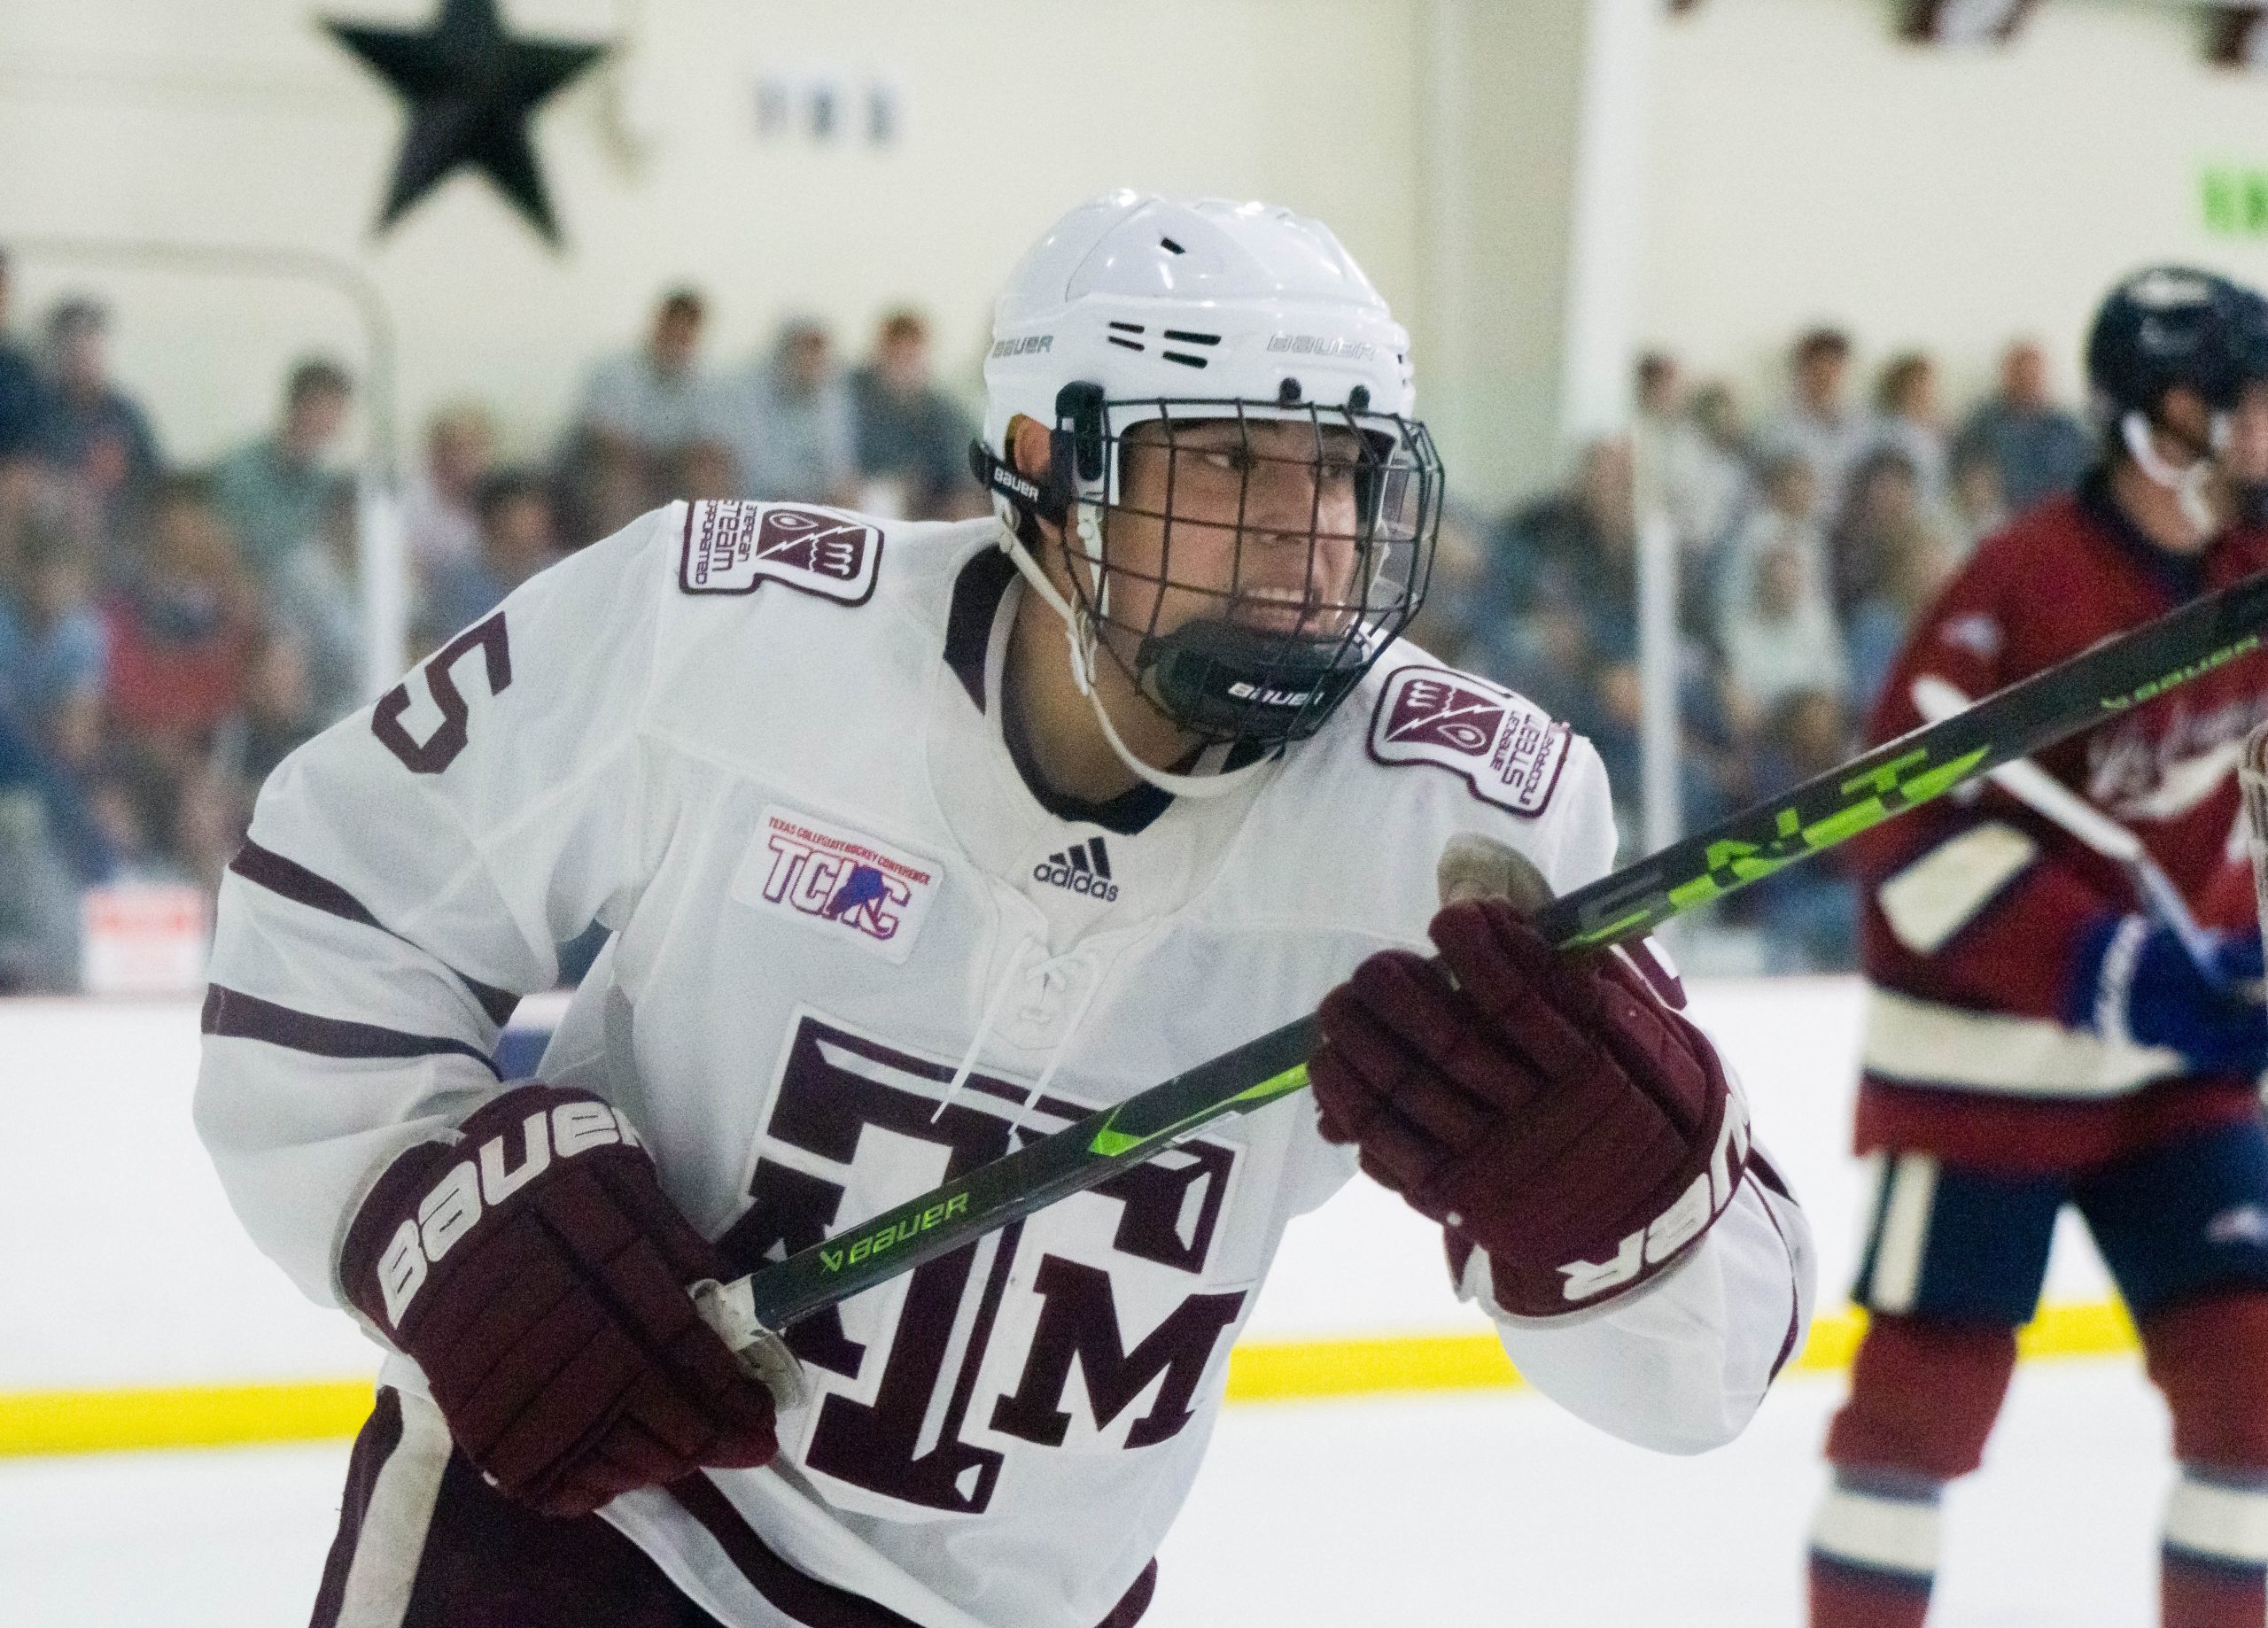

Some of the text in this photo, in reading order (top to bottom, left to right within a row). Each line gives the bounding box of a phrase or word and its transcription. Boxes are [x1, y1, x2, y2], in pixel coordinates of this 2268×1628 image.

[993, 466, 1039, 503] BAUER
[371, 610, 513, 774] 5
[768, 816, 796, 835] TEXAS
[877, 855, 931, 886] CONFERENCE
[1032, 863, 1118, 903] adidas
[849, 1192, 970, 1265] BAUER
[1556, 1092, 1751, 1301] UER
